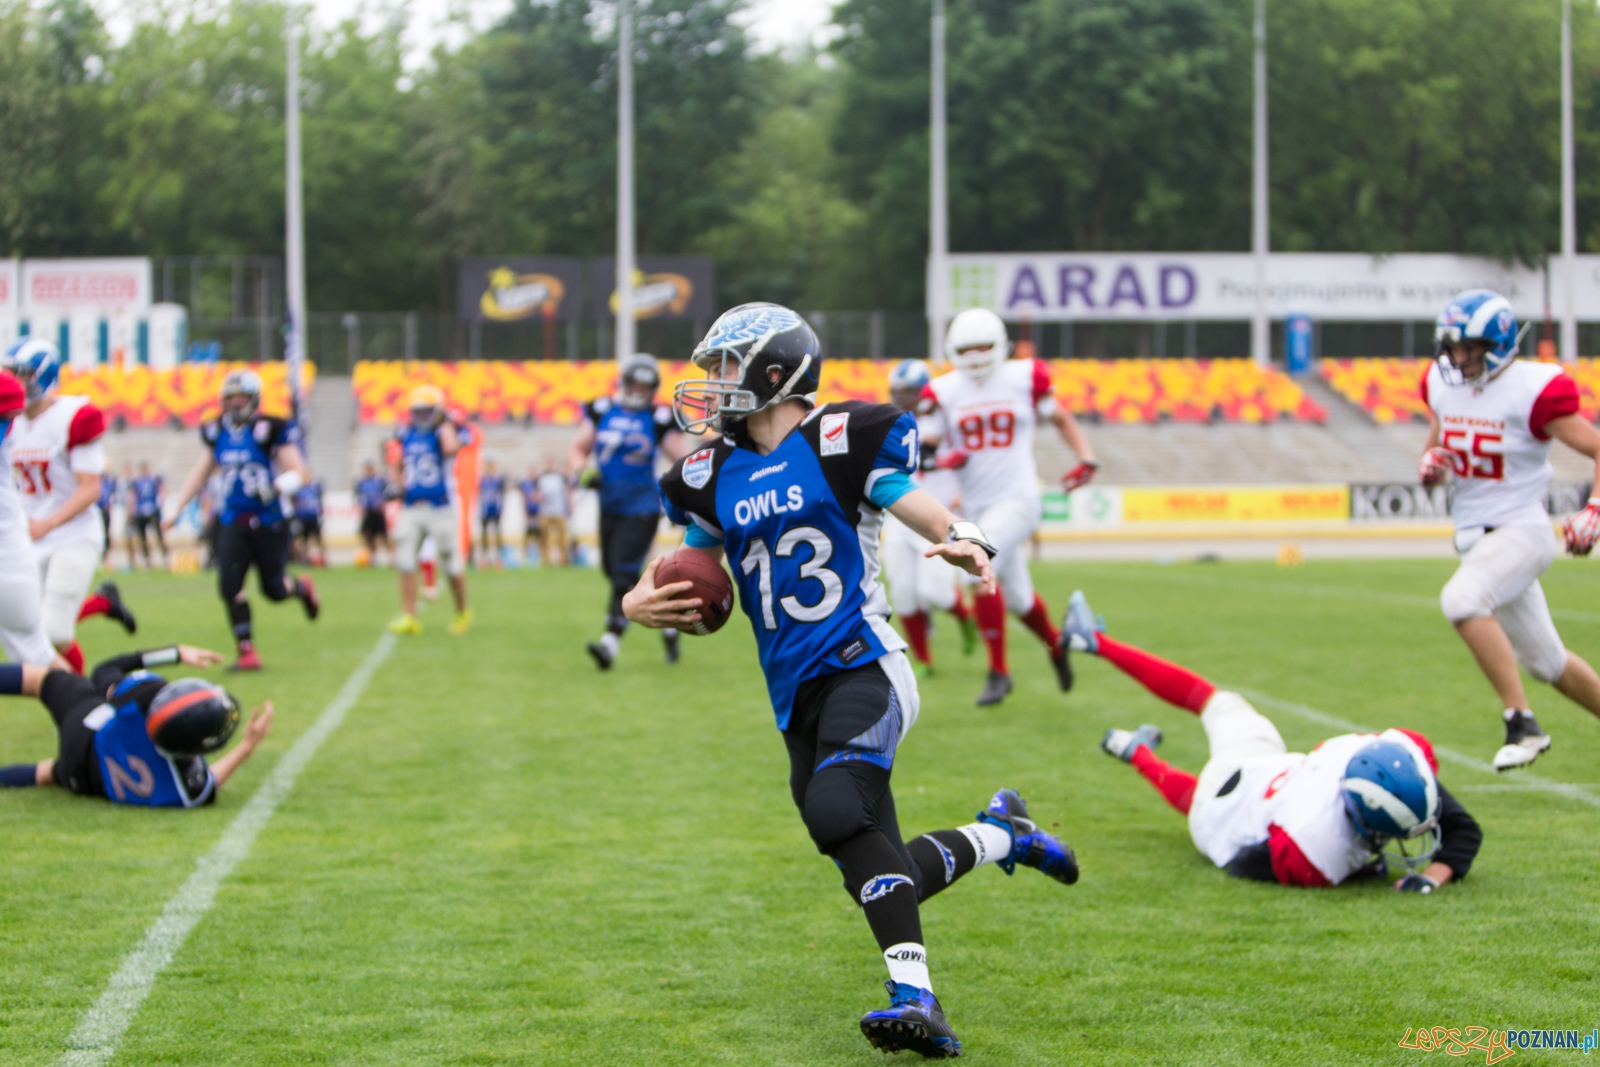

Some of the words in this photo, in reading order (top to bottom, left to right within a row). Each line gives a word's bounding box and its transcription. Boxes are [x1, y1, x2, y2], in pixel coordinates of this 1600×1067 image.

[1007, 264, 1197, 308] ARAD
[597, 430, 651, 466] 72
[822, 443, 846, 454] PLFA
[901, 428, 920, 468] 1
[959, 411, 1015, 451] 99
[1443, 430, 1504, 481] 55
[734, 485, 804, 526] OWLS
[740, 525, 844, 632] 13
